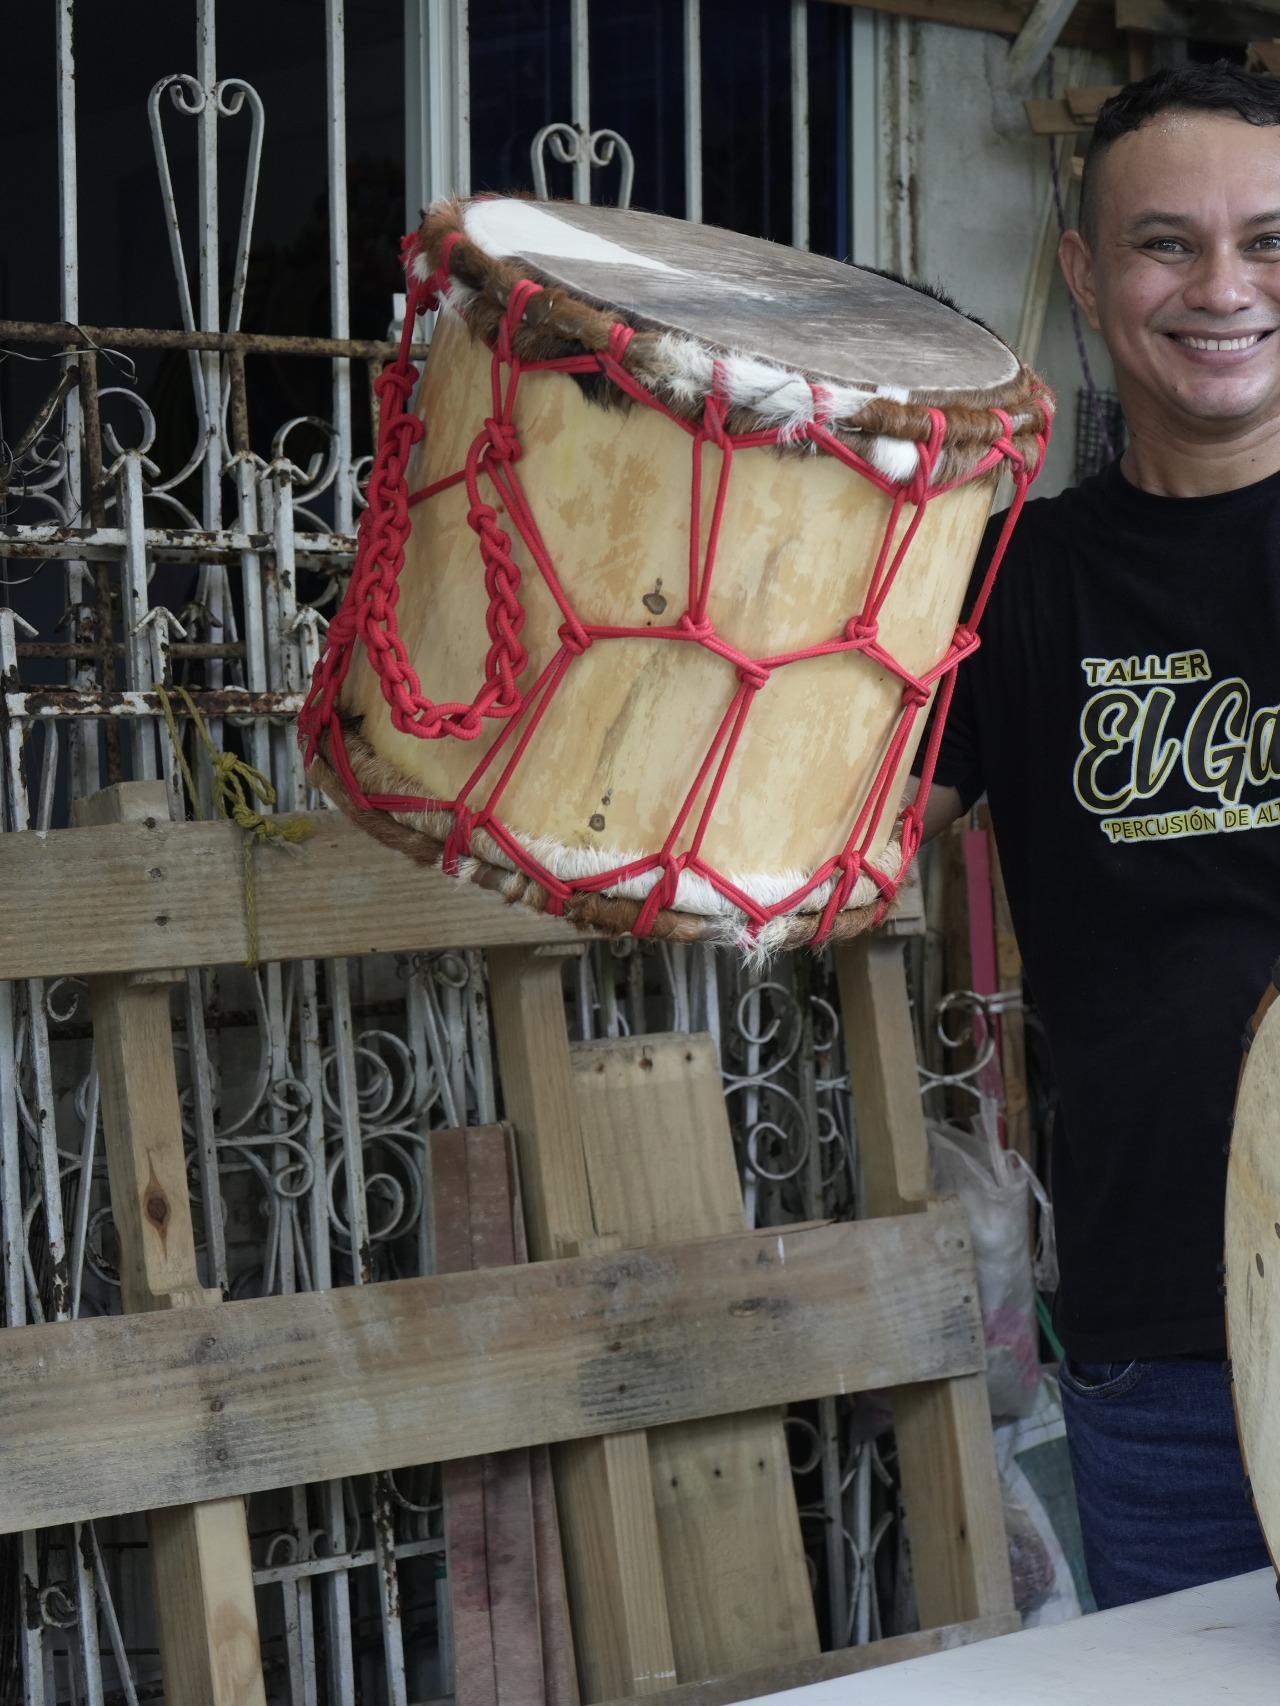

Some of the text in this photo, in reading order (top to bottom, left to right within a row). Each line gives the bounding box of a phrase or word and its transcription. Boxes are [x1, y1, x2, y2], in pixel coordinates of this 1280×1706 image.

[1084, 651, 1210, 685] TALLER
[1074, 686, 1181, 815] El
[1103, 810, 1217, 841] "PERCUSIÓN
[1223, 808, 1250, 829] DE
